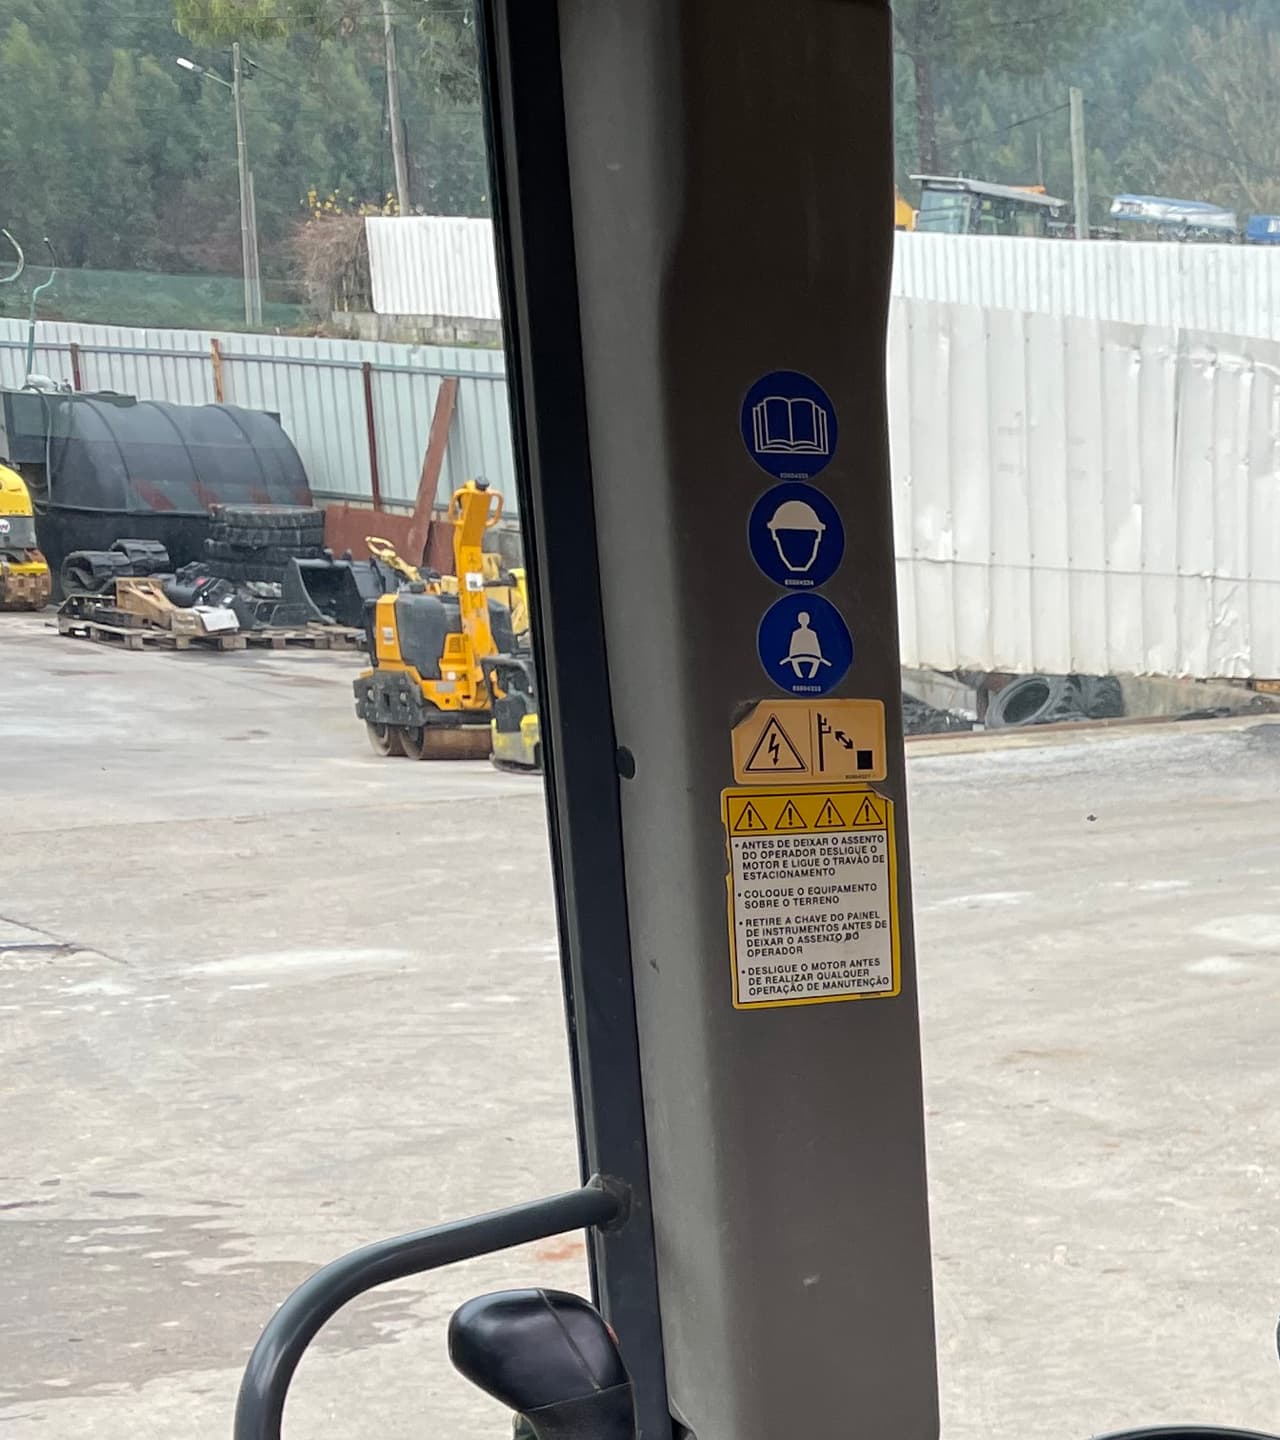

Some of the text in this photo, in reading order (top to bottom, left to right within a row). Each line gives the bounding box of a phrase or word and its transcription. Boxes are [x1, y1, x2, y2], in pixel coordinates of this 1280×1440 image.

[742, 840, 775, 850] ANTES
[777, 839, 791, 848] DE
[793, 837, 829, 848] DEIXAR
[841, 834, 885, 845] ASSENTO
[742, 851, 757, 860] DO
[760, 848, 817, 859] OPERADOR
[820, 845, 867, 856] DESLIGUE
[742, 860, 780, 871] MOTOR
[791, 858, 821, 868] LIGUE
[872, 854, 885, 864] DE
[743, 867, 836, 881] ESTACIONAMENTO
[744, 887, 794, 899] COLOQUE
[808, 882, 878, 896] EQUIPAMENTO
[744, 898, 780, 910] SOBRE
[793, 895, 840, 907] TERRENO
[745, 916, 782, 927] RETIRE
[794, 913, 827, 924] CHAVE
[830, 912, 845, 922] DO
[847, 911, 881, 921] PAINEL
[746, 920, 888, 938] DE INSTRUMENTOS ANTES DE
[746, 937, 784, 948] DEIXAR
[797, 932, 843, 944] ASSENTO
[747, 945, 804, 958] OPERADOR
[748, 963, 798, 976] DESLIGUE
[811, 960, 847, 971] MOTOR
[849, 957, 881, 968] ANTES
[748, 968, 870, 986] DE REALIZAR QUALQUER
[806, 982, 820, 991] DE
